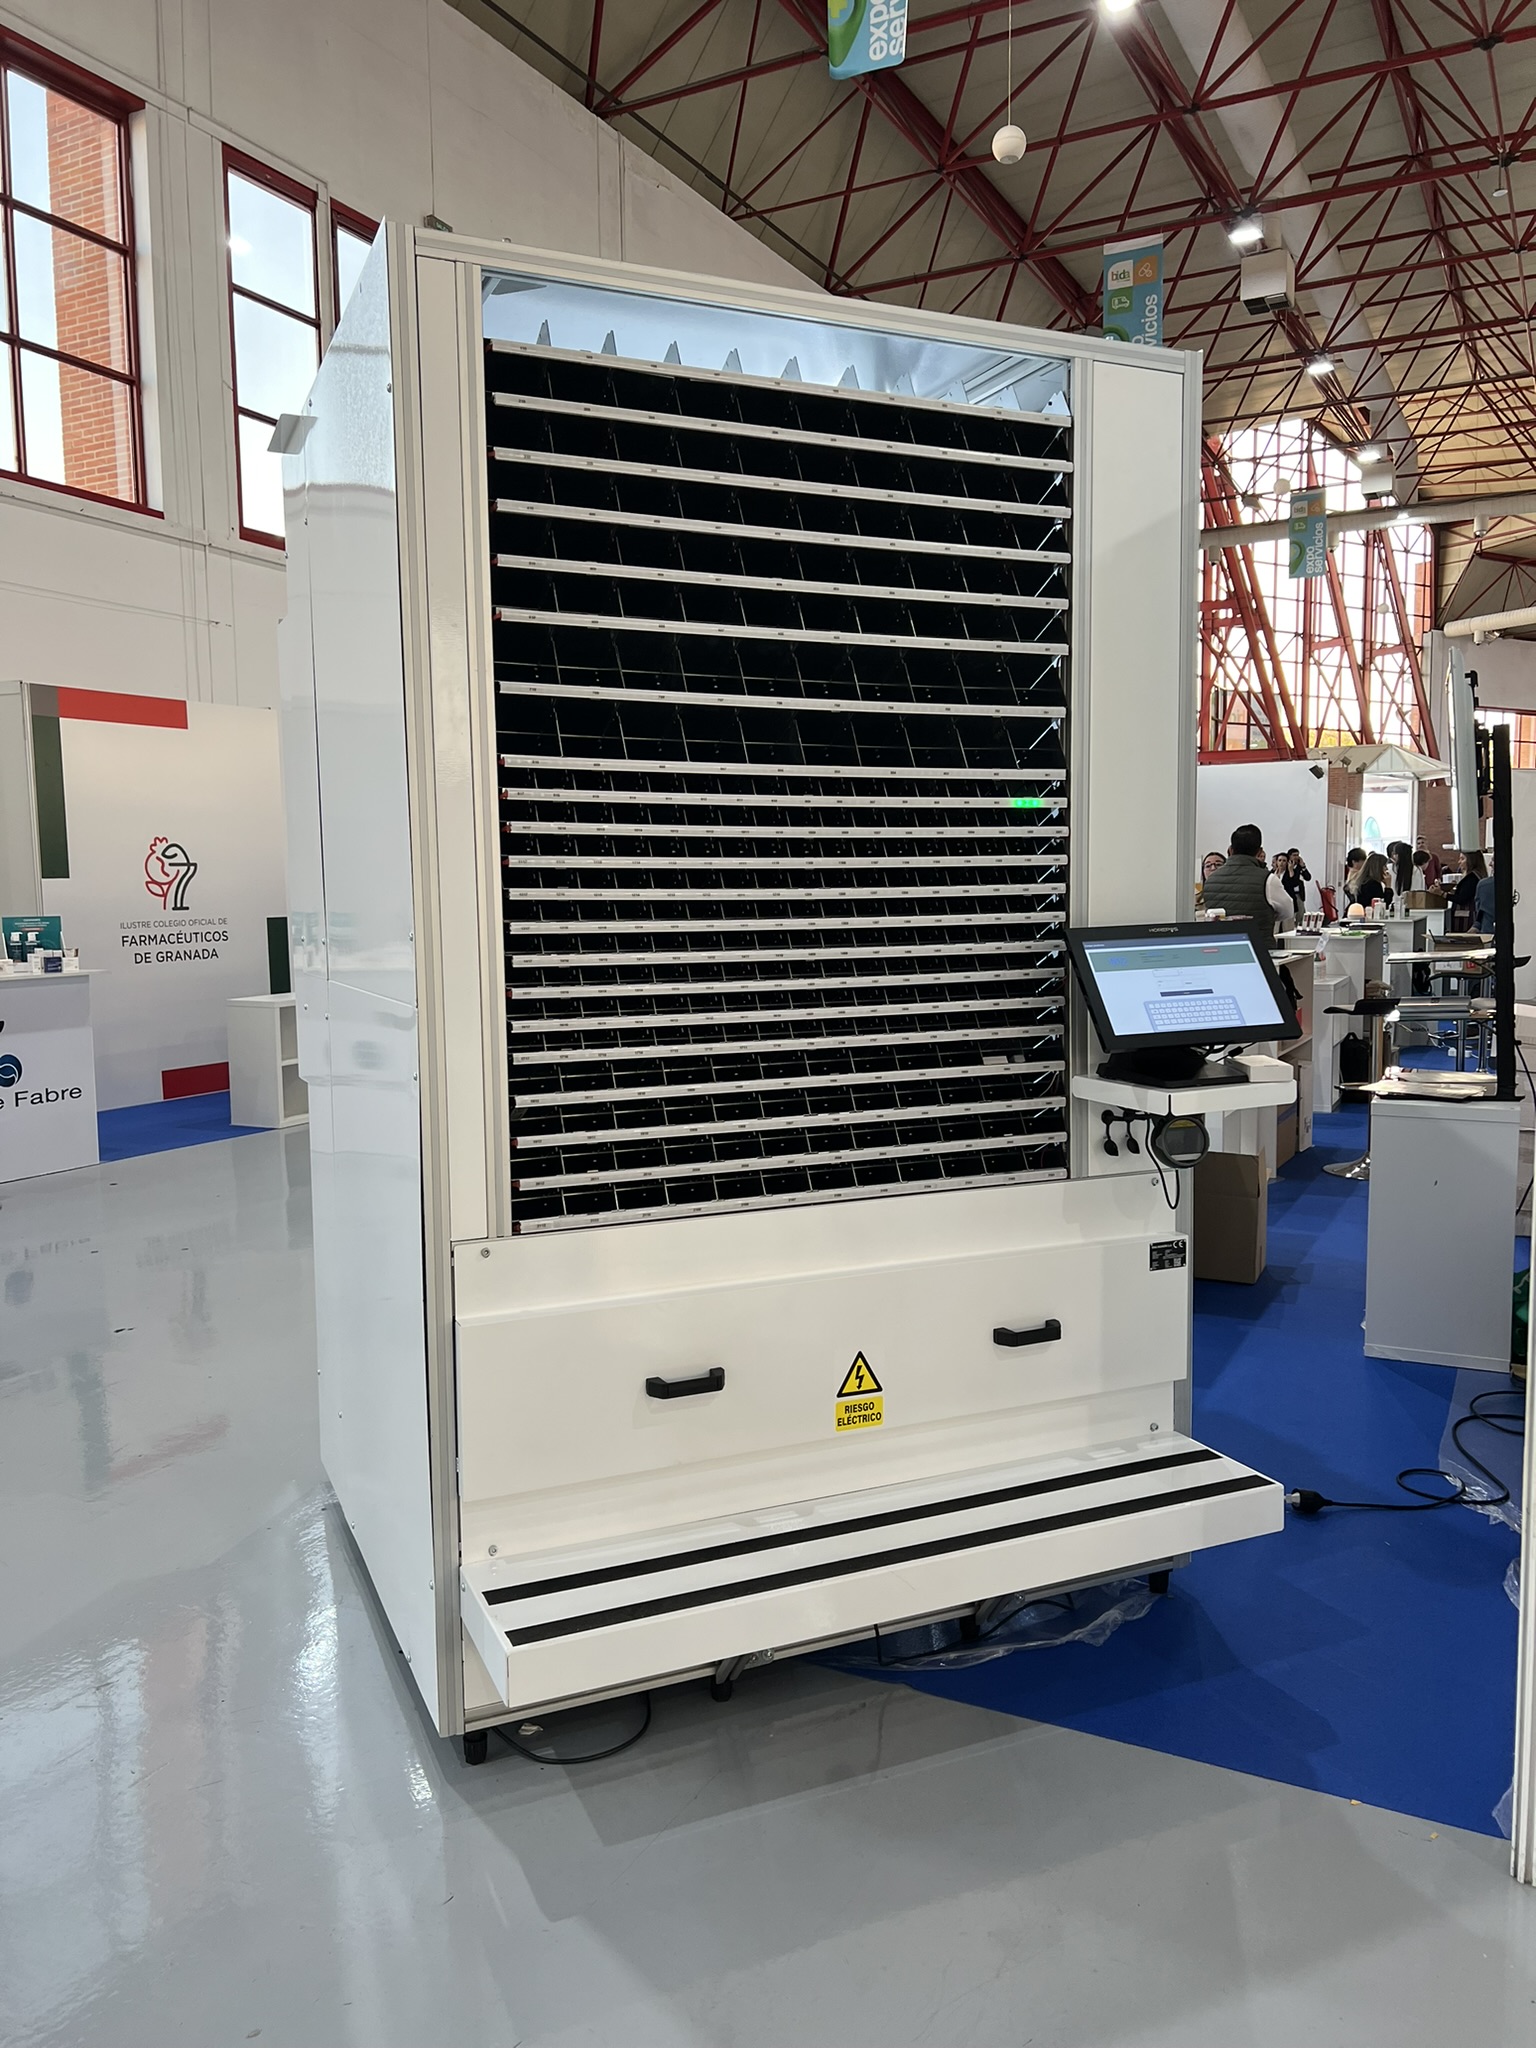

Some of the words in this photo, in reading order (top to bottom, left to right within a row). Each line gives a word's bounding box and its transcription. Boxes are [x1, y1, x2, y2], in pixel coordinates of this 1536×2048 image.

[869, 0, 888, 60] exp
[1111, 268, 1130, 281] bida
[1313, 522, 1324, 573] servicios
[1306, 546, 1315, 574] expo
[120, 920, 151, 929] ILUSTRE
[153, 919, 187, 928] COLEGIO
[188, 918, 216, 927] OFICIAL
[217, 917, 228, 925] DE
[121, 930, 229, 947] FARMACÉUTICOS
[134, 952, 152, 965] DE
[155, 948, 219, 963] GRANADA
[15, 1087, 82, 1108] Fabre
[844, 1402, 875, 1414] RIESGO
[837, 1412, 882, 1426] ELÉCTRICO
